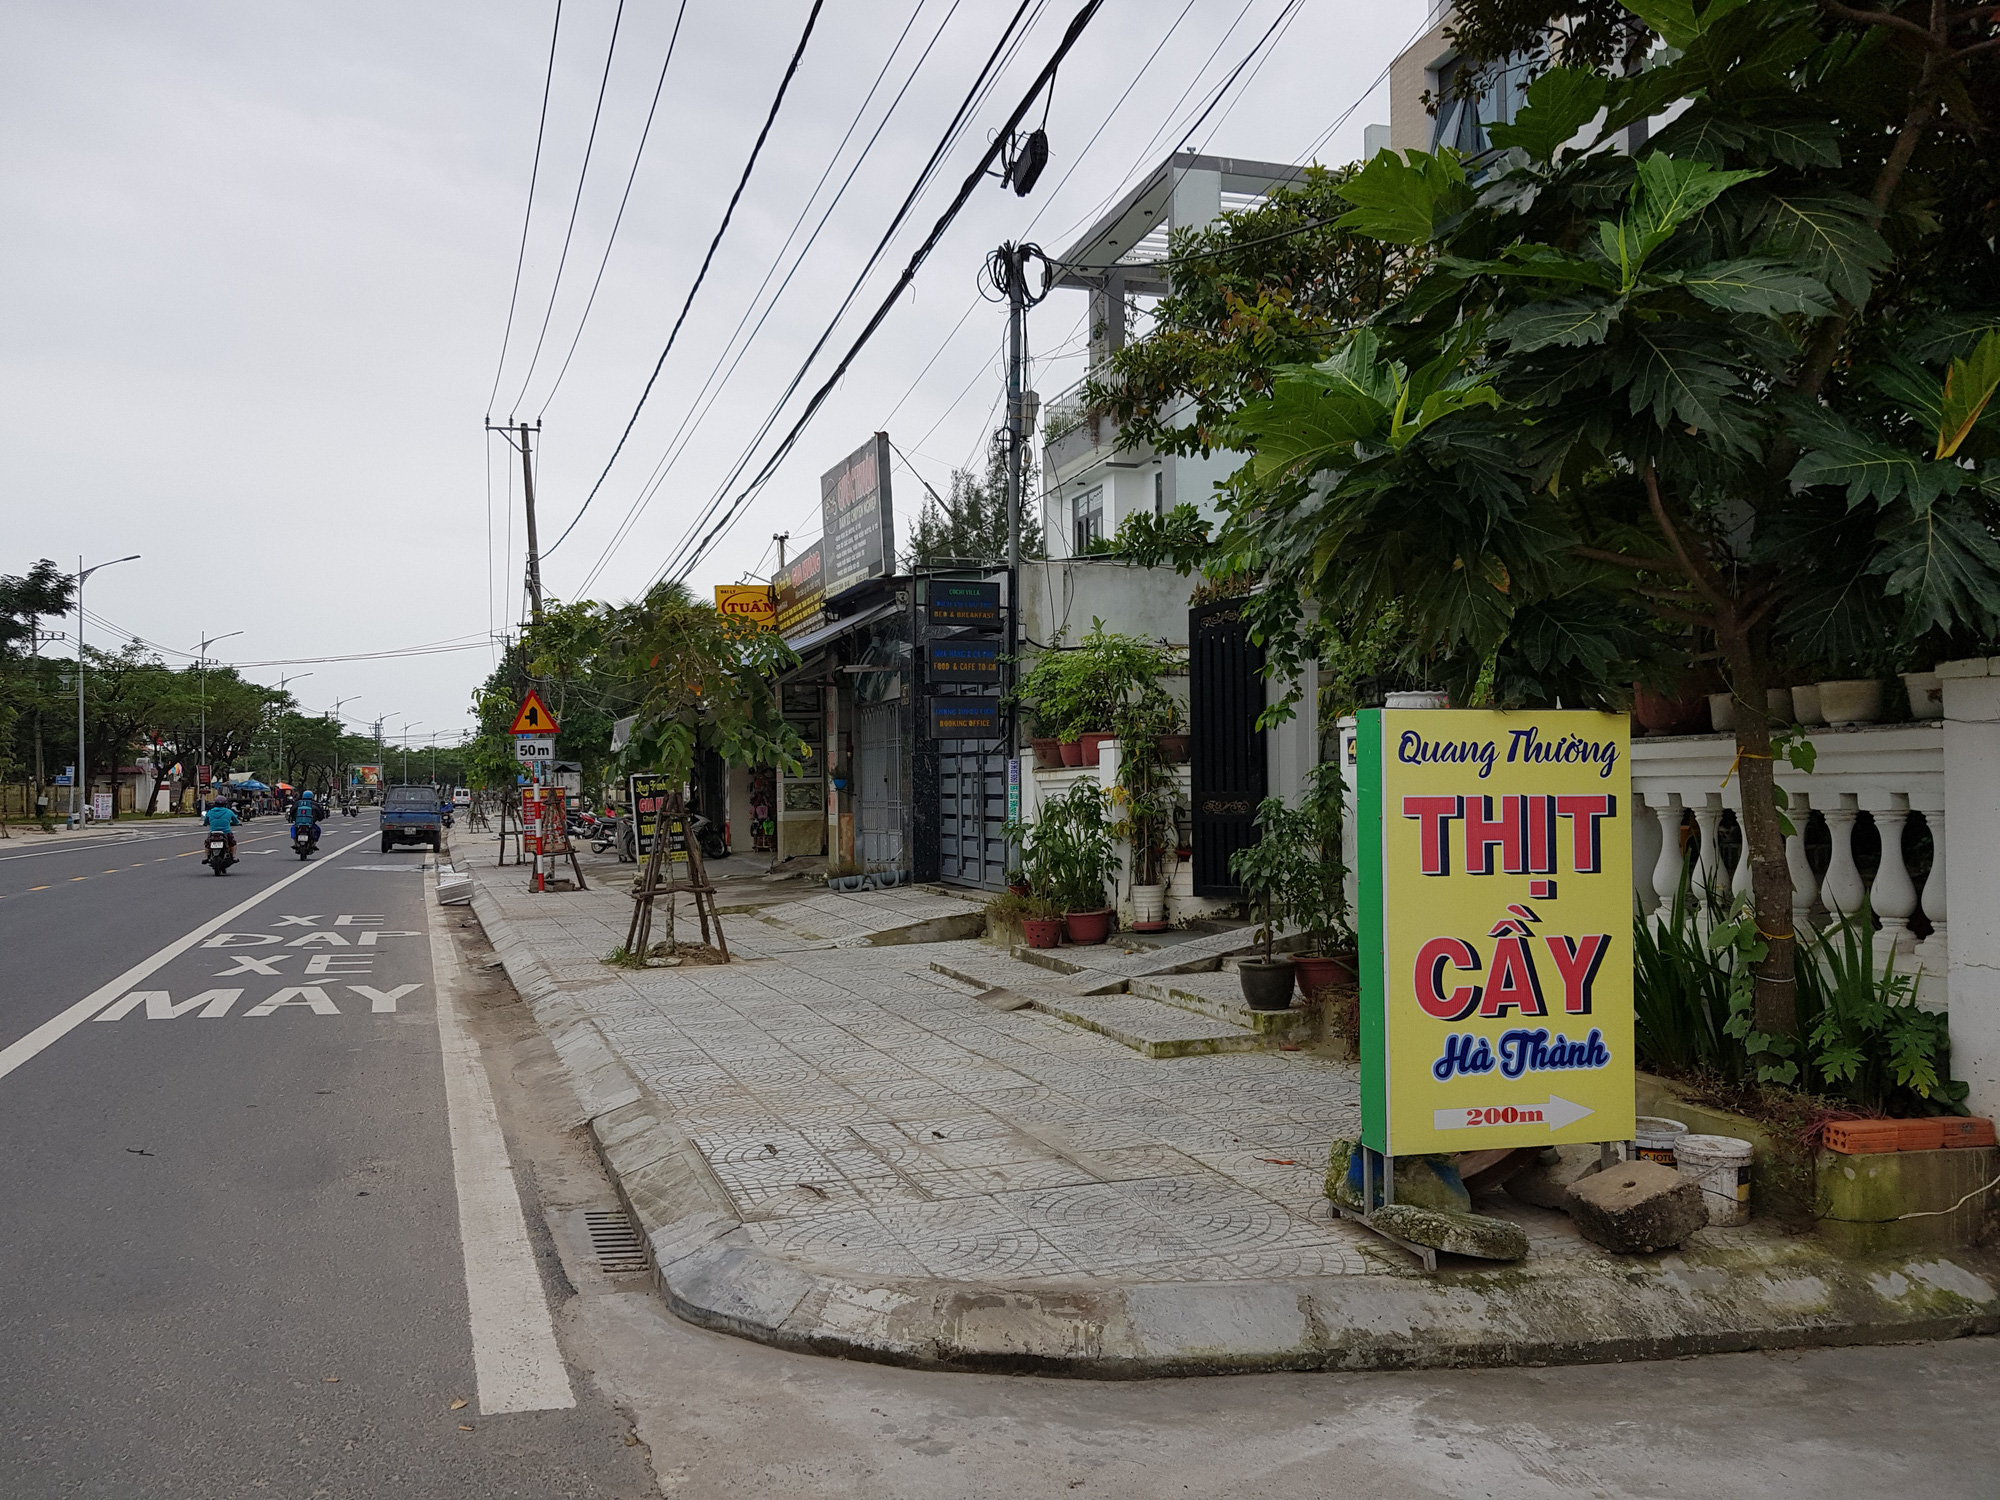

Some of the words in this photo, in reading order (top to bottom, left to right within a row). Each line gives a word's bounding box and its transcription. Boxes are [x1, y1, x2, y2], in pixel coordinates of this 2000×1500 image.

[727, 599, 775, 613] TUẤN
[956, 612, 995, 620] BREAKFAST
[933, 662, 950, 671] FOOD
[960, 662, 976, 671] CAFE
[978, 663, 986, 671] TO
[939, 720, 967, 728] BOOKING
[968, 720, 991, 728] OFFICE
[1398, 729, 1500, 779] Quang
[1506, 726, 1621, 779] Thường
[639, 797, 655, 813] GIA
[1402, 793, 1617, 899] THỊT
[269, 914, 385, 927] XE
[200, 931, 422, 950] ĐẠP
[211, 953, 375, 977] XE
[1413, 903, 1613, 1022] CẦY
[92, 978, 424, 1022] MÁY
[1432, 1032, 1497, 1083] Hà
[1498, 1026, 1611, 1080] Thành
[1466, 1106, 1544, 1127] 200m
